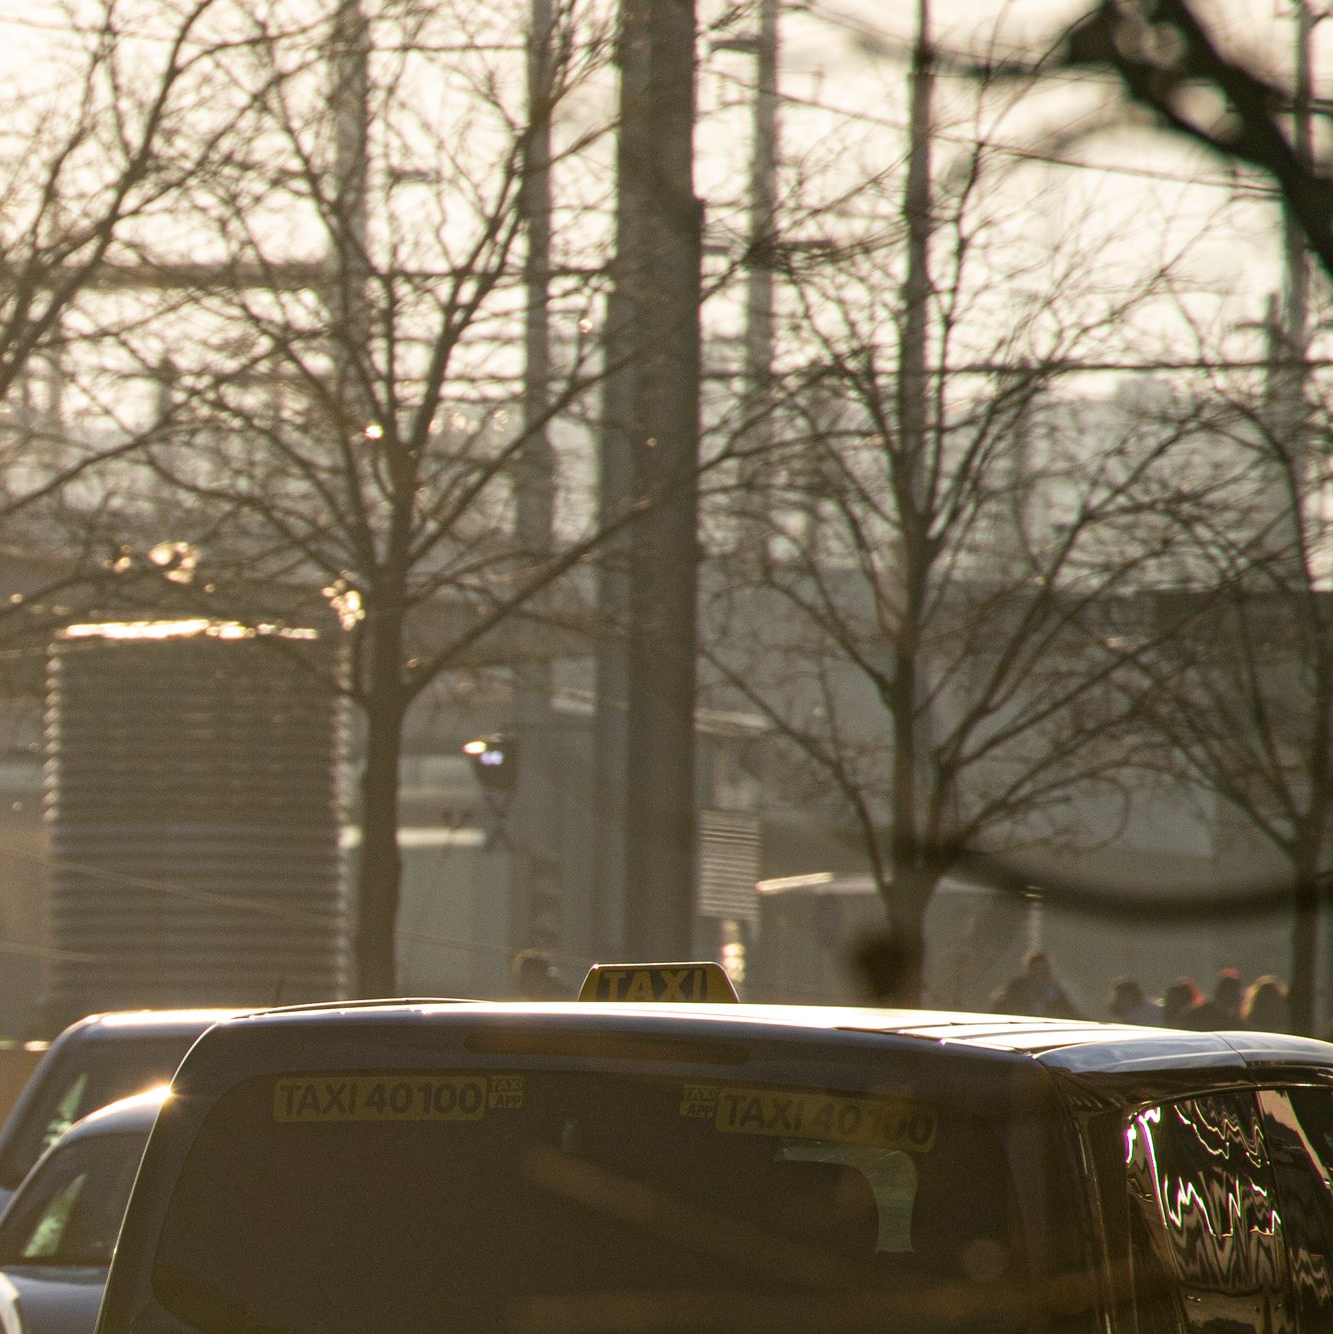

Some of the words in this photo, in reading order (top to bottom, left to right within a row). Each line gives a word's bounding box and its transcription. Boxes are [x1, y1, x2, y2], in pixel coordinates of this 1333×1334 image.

[601, 969, 704, 1002] TAXI
[279, 1082, 358, 1116] TAXI
[495, 1094, 523, 1107] APP
[686, 1103, 713, 1117] APP
[723, 1093, 807, 1132] TAXI
